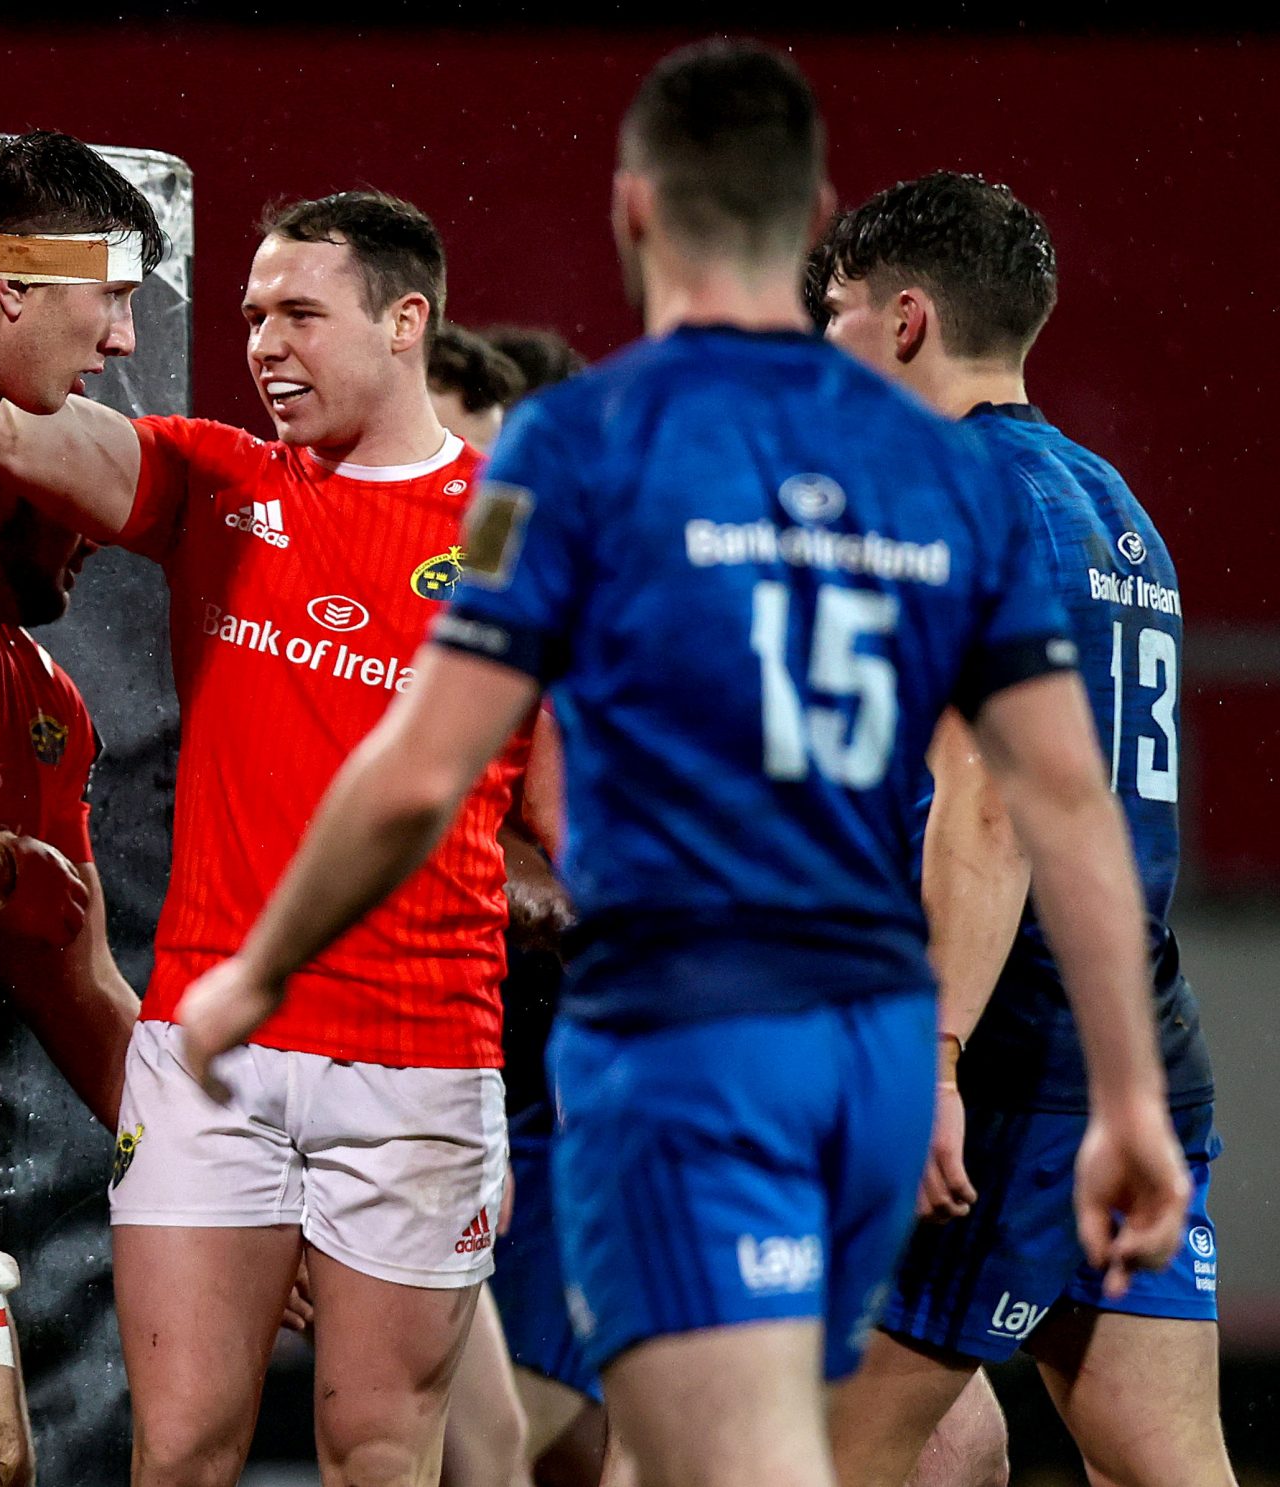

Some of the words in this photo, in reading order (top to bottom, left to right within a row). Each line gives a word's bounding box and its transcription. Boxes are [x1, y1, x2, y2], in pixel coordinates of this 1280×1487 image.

[225, 511, 290, 548] adidas
[685, 518, 777, 568] Bank
[816, 529, 951, 587] Ireland
[1088, 568, 1120, 604] Bank
[1121, 575, 1134, 606] of
[1137, 576, 1182, 618] Irelan
[202, 603, 281, 656] Bank
[285, 636, 333, 670] of
[332, 644, 417, 694] Irela
[750, 580, 900, 791] 15
[1110, 621, 1179, 803] 13
